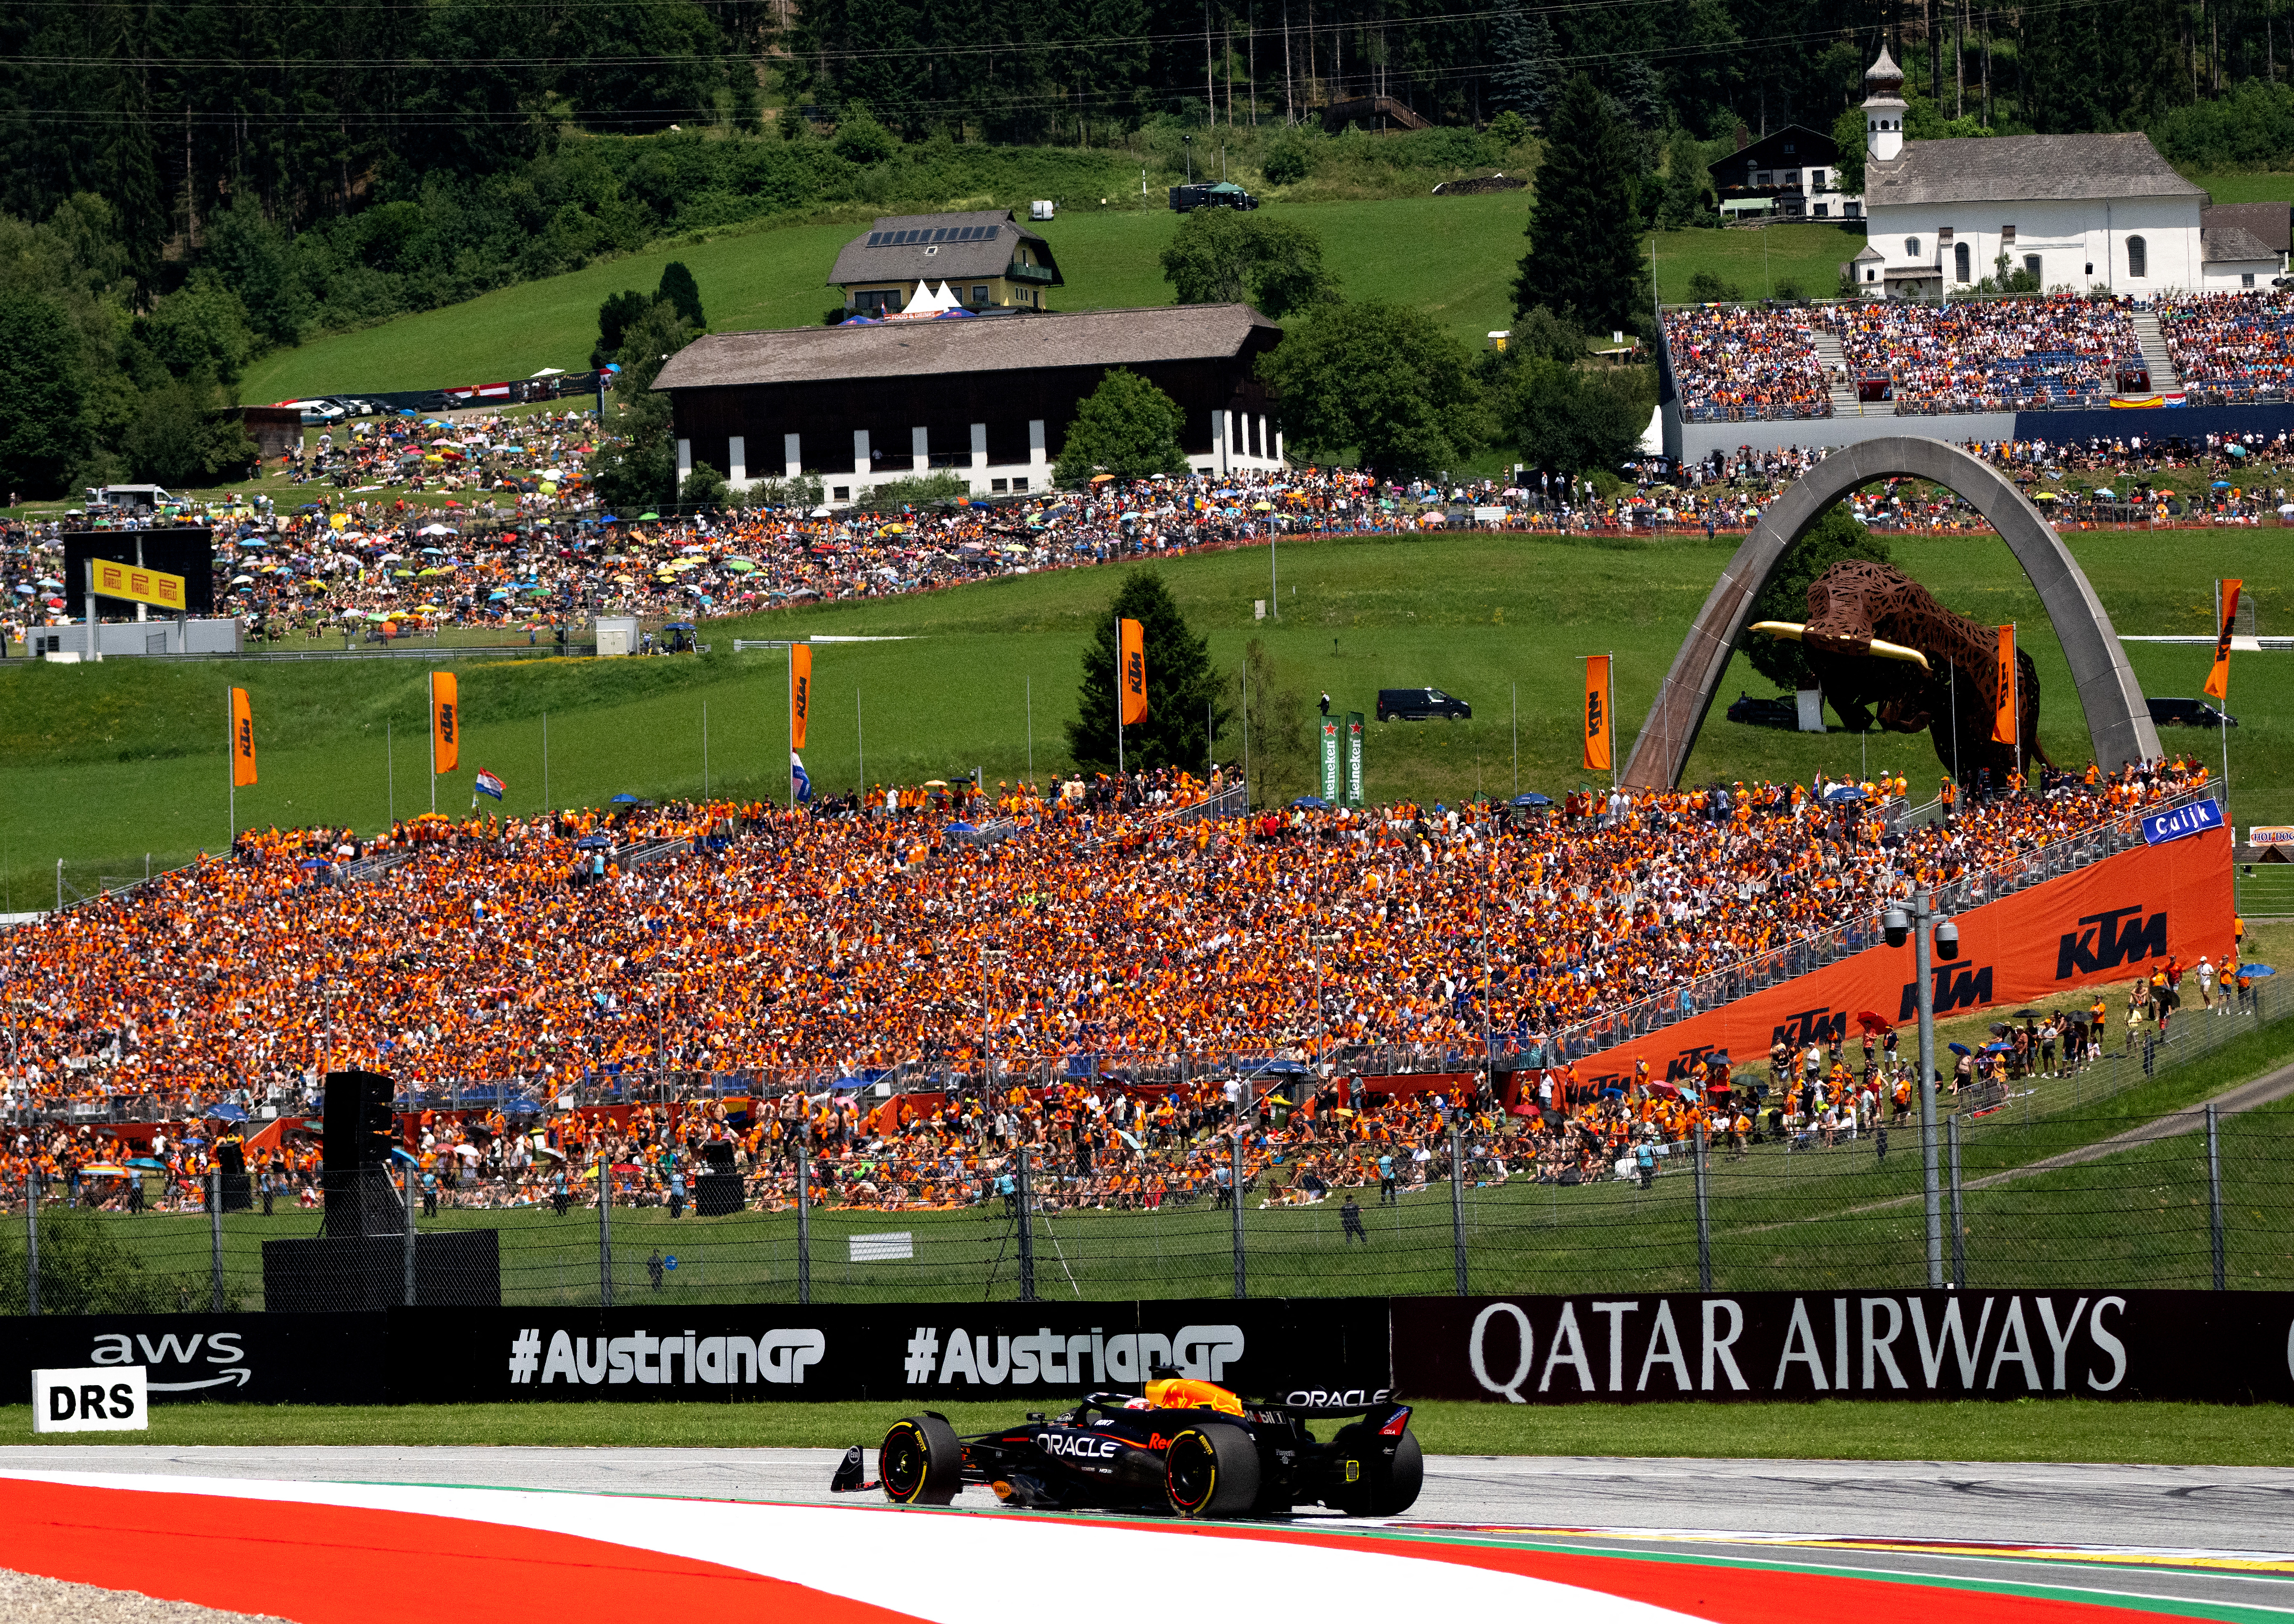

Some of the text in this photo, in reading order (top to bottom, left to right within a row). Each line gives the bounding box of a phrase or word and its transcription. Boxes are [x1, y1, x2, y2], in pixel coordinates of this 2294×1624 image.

[1128, 651, 1142, 695] KTM
[797, 676, 807, 719] KTM
[1588, 691, 1602, 738] KTM
[240, 718, 251, 758] KTM
[440, 703, 454, 745] KTM
[1325, 739, 1335, 800] Heineken
[1350, 739, 1361, 800] Heineken
[2156, 804, 2210, 835] Cuijk
[2254, 833, 2272, 841] HOT
[2056, 904, 2167, 980] KTM
[1771, 1007, 1846, 1048] KTM
[91, 1333, 244, 1364] aws
[509, 1328, 826, 1384] #AustrianGP
[905, 1325, 1245, 1384] #AustrianGP
[1469, 1299, 1750, 1403] QATAR
[1774, 1296, 2127, 1391] AIRWAYS
[50, 1383, 134, 1421] DRS
[1243, 1410, 1285, 1424] Mobil 1
[1286, 1389, 1390, 1407] ORACLE
[1037, 1434, 1122, 1458] ORACLE
[1149, 1433, 1173, 1449] Re
